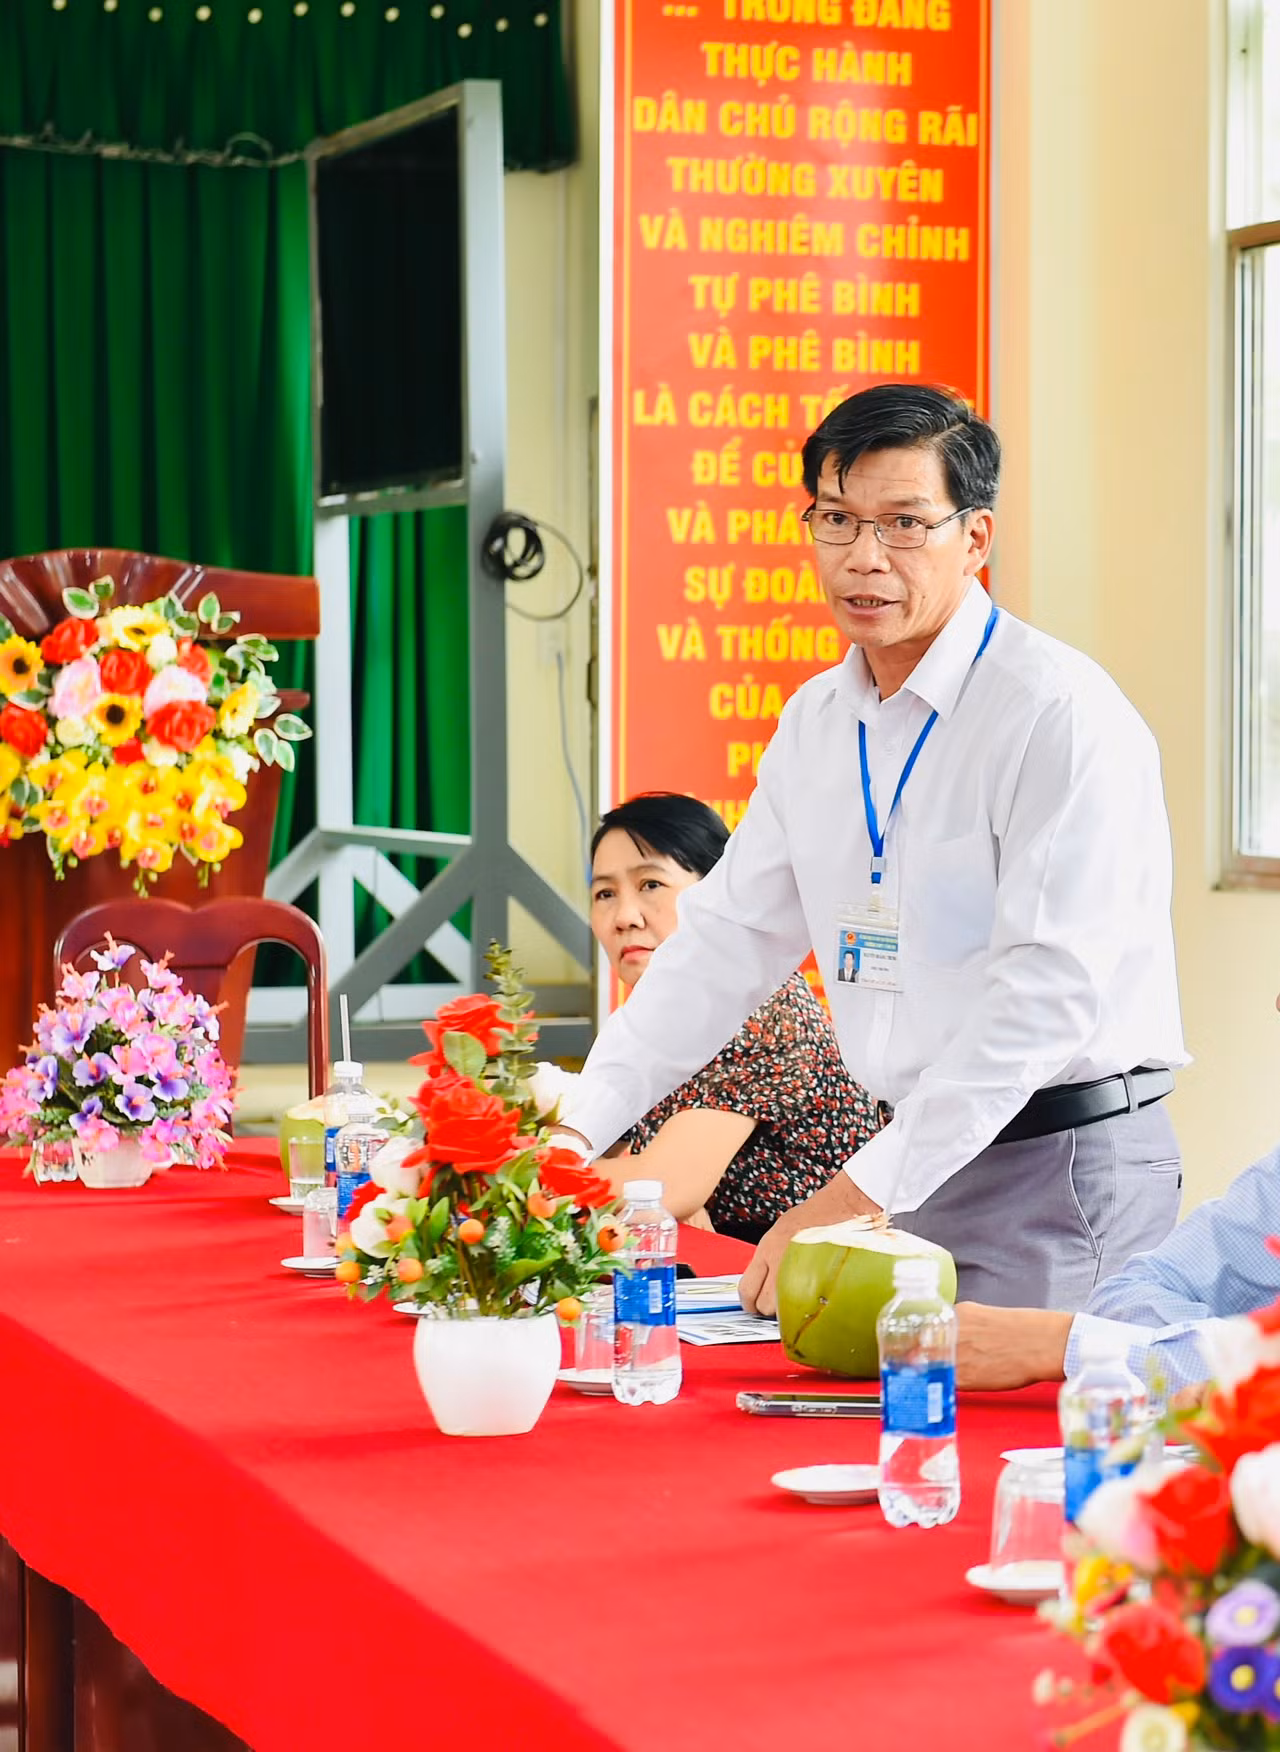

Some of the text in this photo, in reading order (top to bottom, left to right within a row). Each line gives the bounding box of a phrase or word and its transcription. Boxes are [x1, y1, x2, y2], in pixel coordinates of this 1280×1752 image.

[702, 41, 914, 87] THỰC HÀNH
[633, 90, 978, 149] DÂN CHỦ RỘNG RÃI
[666, 153, 944, 203] THƯỜNG XUYÊN
[639, 207, 970, 262] VÀ NGHIÊM CHỈNH
[688, 272, 921, 319] TỰ PHÊ BÌNH
[688, 326, 921, 375] VÀ PHÊ BÌNH
[633, 382, 678, 427] LÀ
[688, 386, 790, 429] CÁCH
[691, 436, 804, 488] ĐỂ CỦ
[667, 501, 816, 545] VÀ PHÁ
[684, 560, 828, 609] SỰ ĐOÀ
[656, 615, 841, 662] VÀ THỐNG
[709, 673, 782, 720] CỦA
